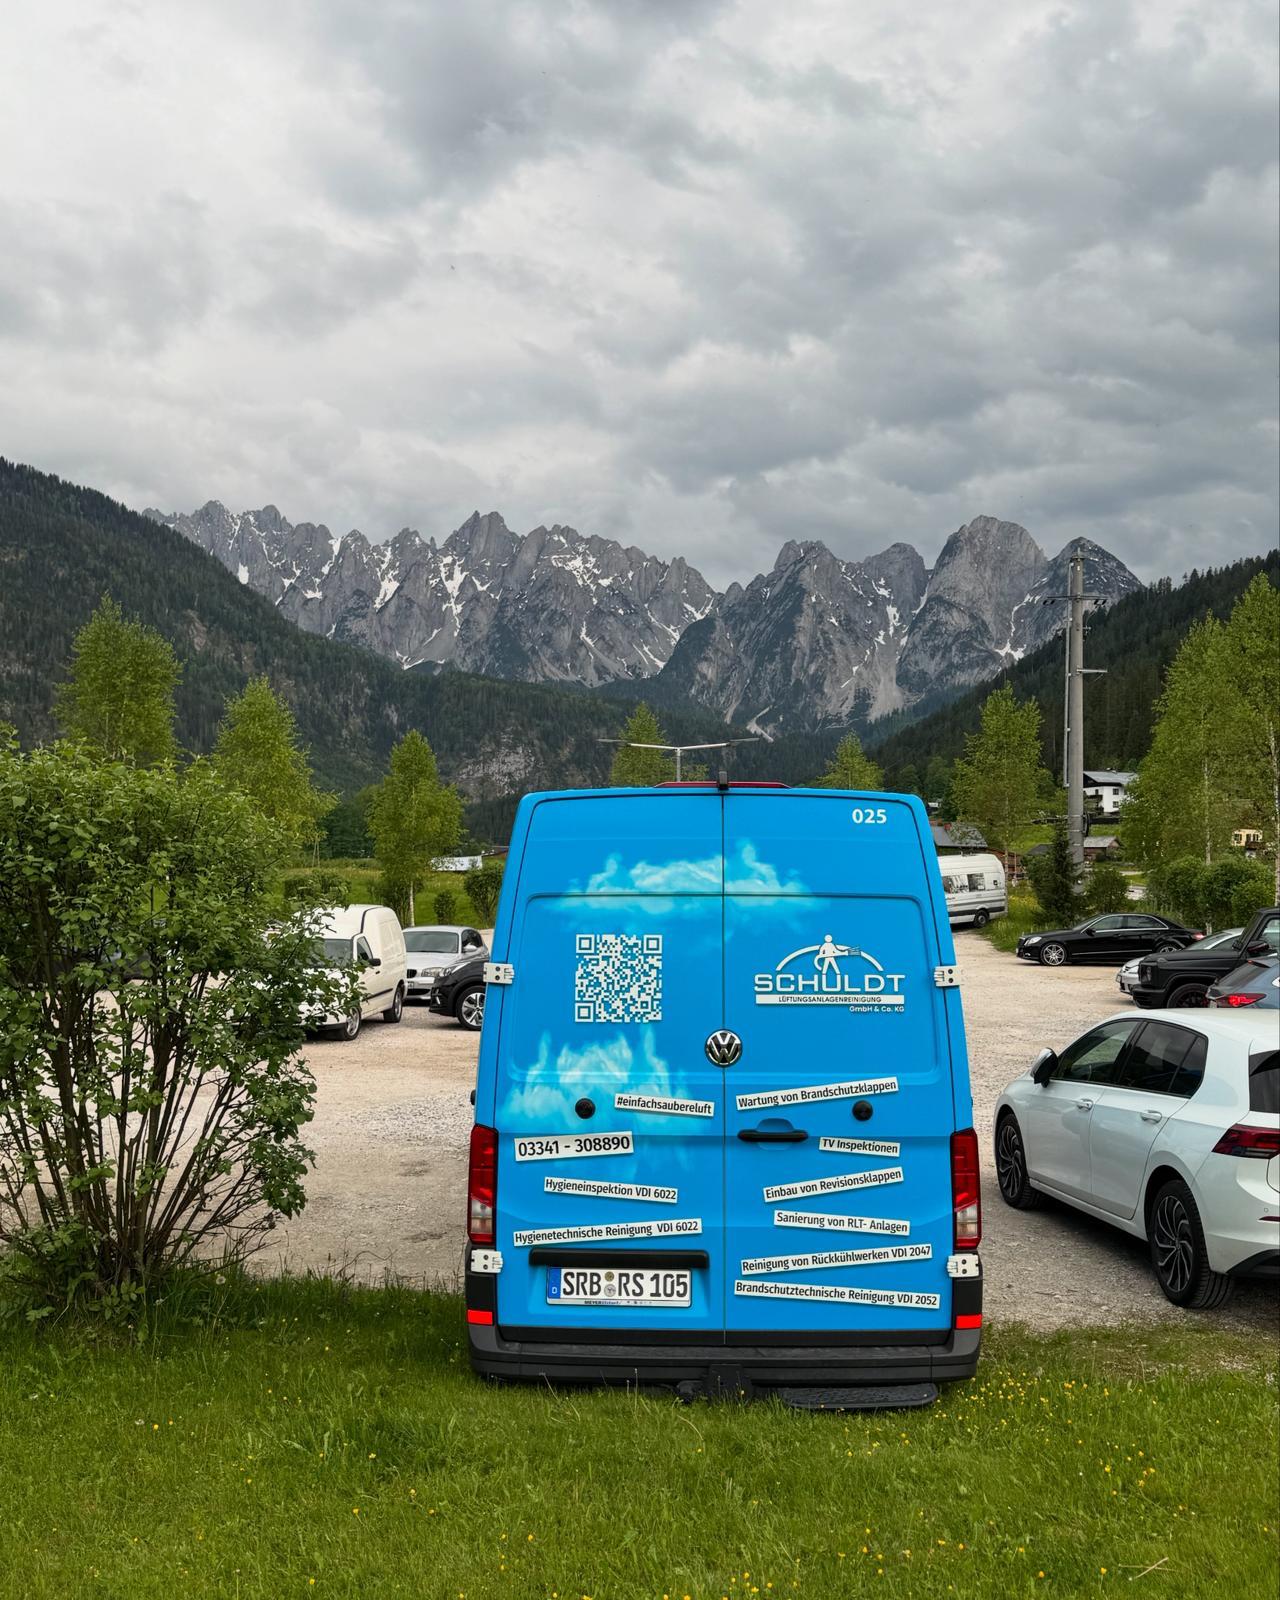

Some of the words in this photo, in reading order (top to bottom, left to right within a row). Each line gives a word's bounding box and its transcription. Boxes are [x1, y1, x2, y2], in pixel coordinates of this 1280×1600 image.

[852, 808, 887, 824] 025
[754, 974, 905, 992] SCHULDT
[738, 1094, 779, 1108] Wartung
[781, 1093, 798, 1102] von
[801, 1080, 897, 1101] Brandschutzklappen
[616, 1096, 712, 1114] #einfachsaubereluft
[518, 1141, 560, 1157] 03341
[575, 1136, 630, 1152] 308890
[822, 1139, 835, 1148] TV
[837, 1139, 898, 1154] Inspektionen
[545, 1179, 633, 1197] Hygieneinspektion
[635, 1187, 651, 1197] VDI
[653, 1190, 677, 1200] 6022
[766, 1186, 798, 1199] Einbau
[800, 1184, 818, 1193] von
[820, 1170, 902, 1190] Revisionsklappen
[515, 1228, 603, 1244] Hygienetechnische
[605, 1223, 653, 1238] Reinigung
[657, 1223, 673, 1233] VDI
[675, 1221, 698, 1232] 6022
[776, 1212, 825, 1227] Sanierung
[827, 1217, 845, 1227] von
[847, 1218, 867, 1228] RLT-
[869, 1220, 908, 1233] Anlagen
[742, 1258, 790, 1272] Reinigung
[792, 1257, 809, 1266] von
[812, 1250, 889, 1265] Rückkühlwerken
[891, 1249, 908, 1258] VDI
[909, 1246, 931, 1257] 2047
[563, 1271, 602, 1296] SRB
[618, 1273, 644, 1297] RS
[650, 1273, 688, 1298] 105
[736, 1282, 846, 1299] Brandschutztechnische
[848, 1291, 895, 1304] Reinigung
[897, 1295, 913, 1304] VDI
[915, 1295, 937, 1306] 2052
